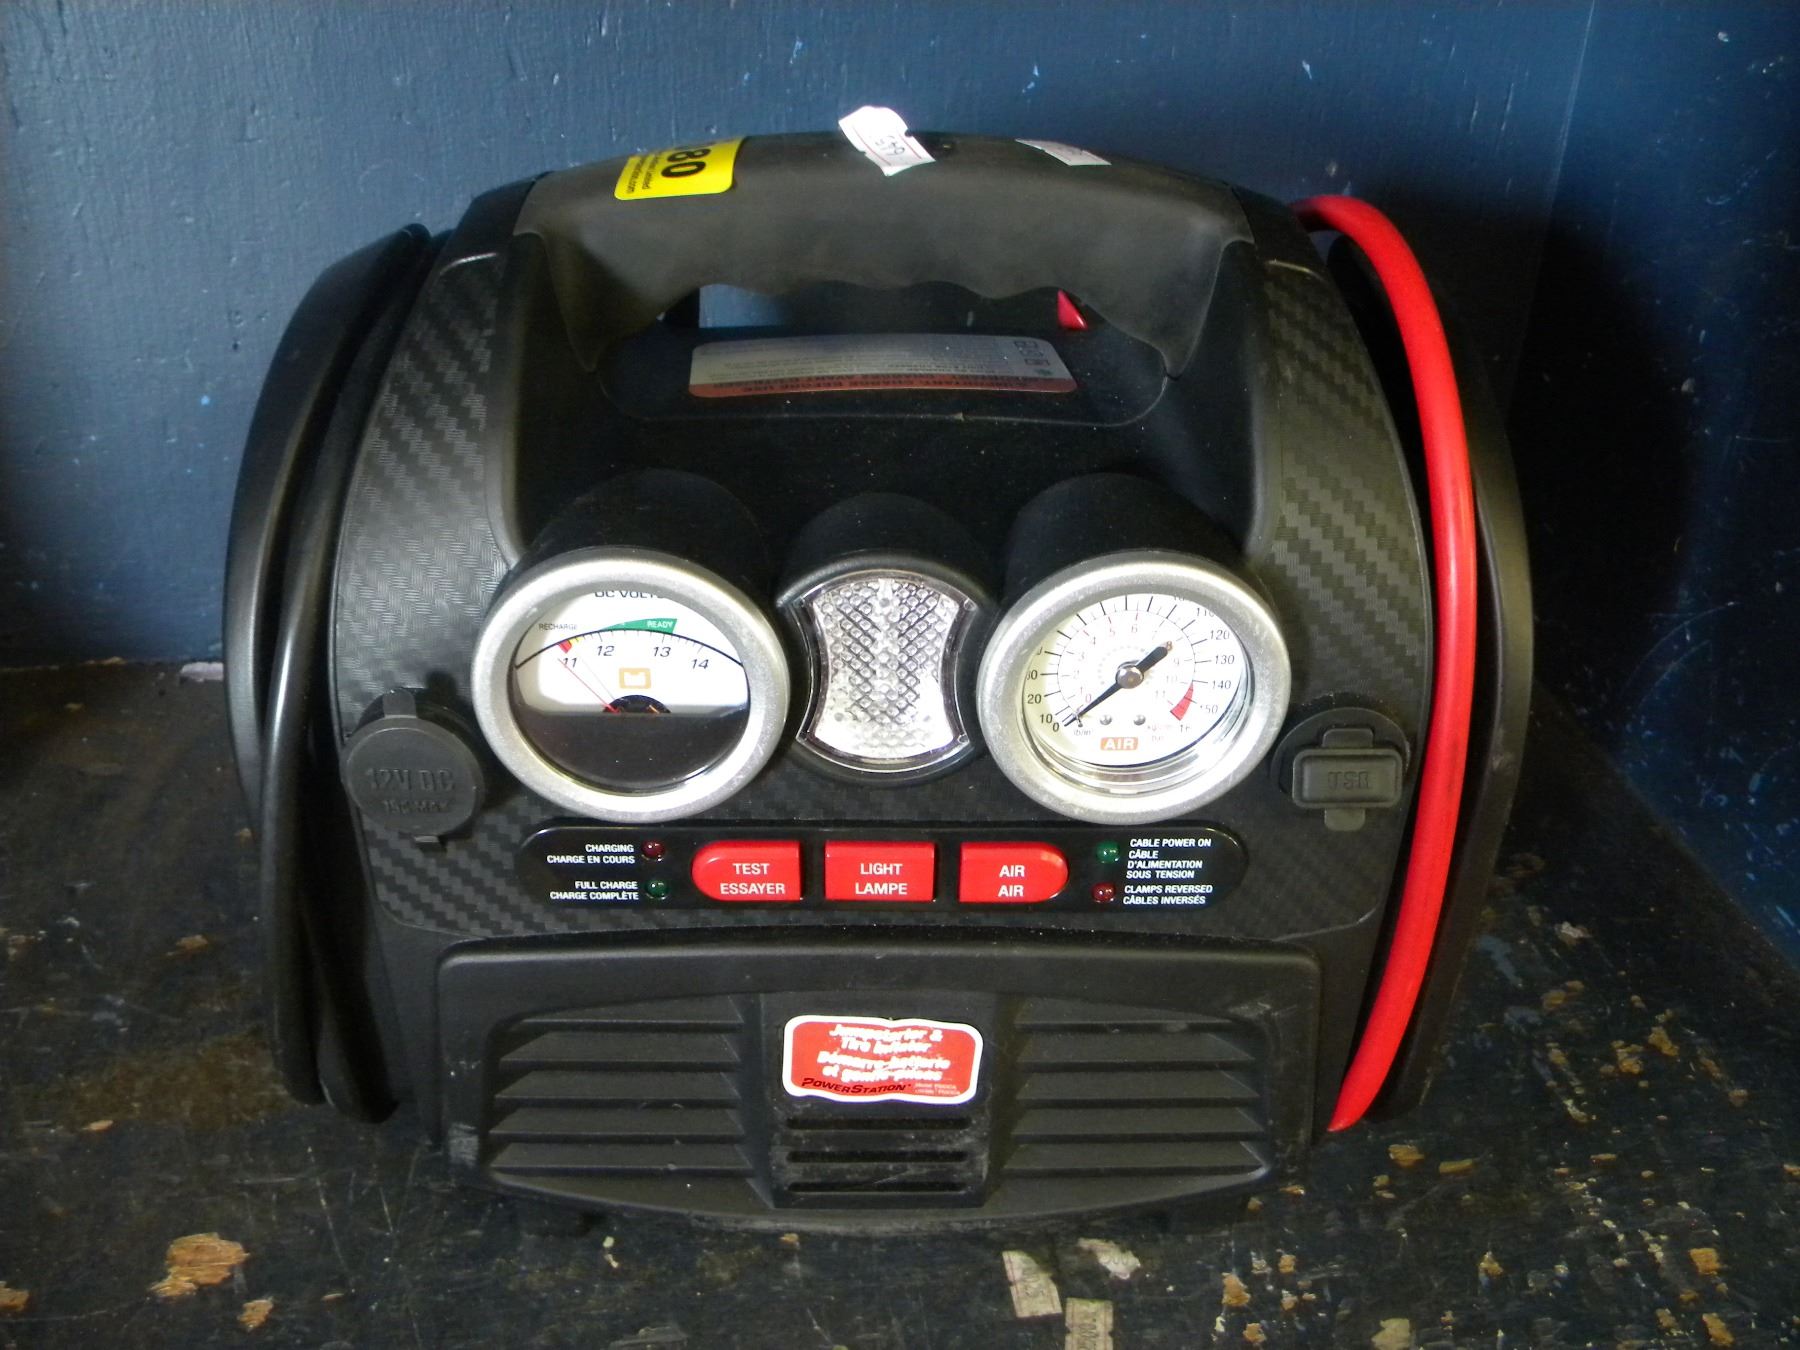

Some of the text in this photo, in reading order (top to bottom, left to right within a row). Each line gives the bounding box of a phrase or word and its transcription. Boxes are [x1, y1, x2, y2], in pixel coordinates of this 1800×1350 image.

[619, 589, 664, 599] VOLT
[646, 619, 674, 629] READY
[1209, 629, 1230, 641] 120
[596, 645, 615, 657] 12
[653, 646, 672, 658] 13
[562, 657, 577, 669] 11
[691, 658, 709, 670] 14
[1215, 654, 1235, 665] 130
[1212, 680, 1232, 690] 140
[1027, 693, 1042, 704] 20
[1040, 713, 1053, 724] 10
[1052, 721, 1060, 732] 0
[1103, 738, 1136, 750] AIR
[585, 843, 634, 853] CHARGING
[1130, 838, 1212, 847] CABLE POWER ON
[547, 855, 635, 864] CHARGE EN COURS
[1127, 860, 1203, 869] D'ALIMENTATION
[733, 863, 770, 875] TEST
[860, 863, 903, 875] LIGHT
[999, 865, 1025, 877] AIR
[1126, 870, 1194, 879] SOUS TENSION
[575, 881, 638, 889] FULL CHARGE
[720, 883, 785, 895] ESSAYER
[855, 883, 908, 895] LAMPE
[1124, 885, 1213, 894] CLAMPS REVERSED
[550, 891, 587, 900] CHARGE
[998, 885, 1024, 897] AIR
